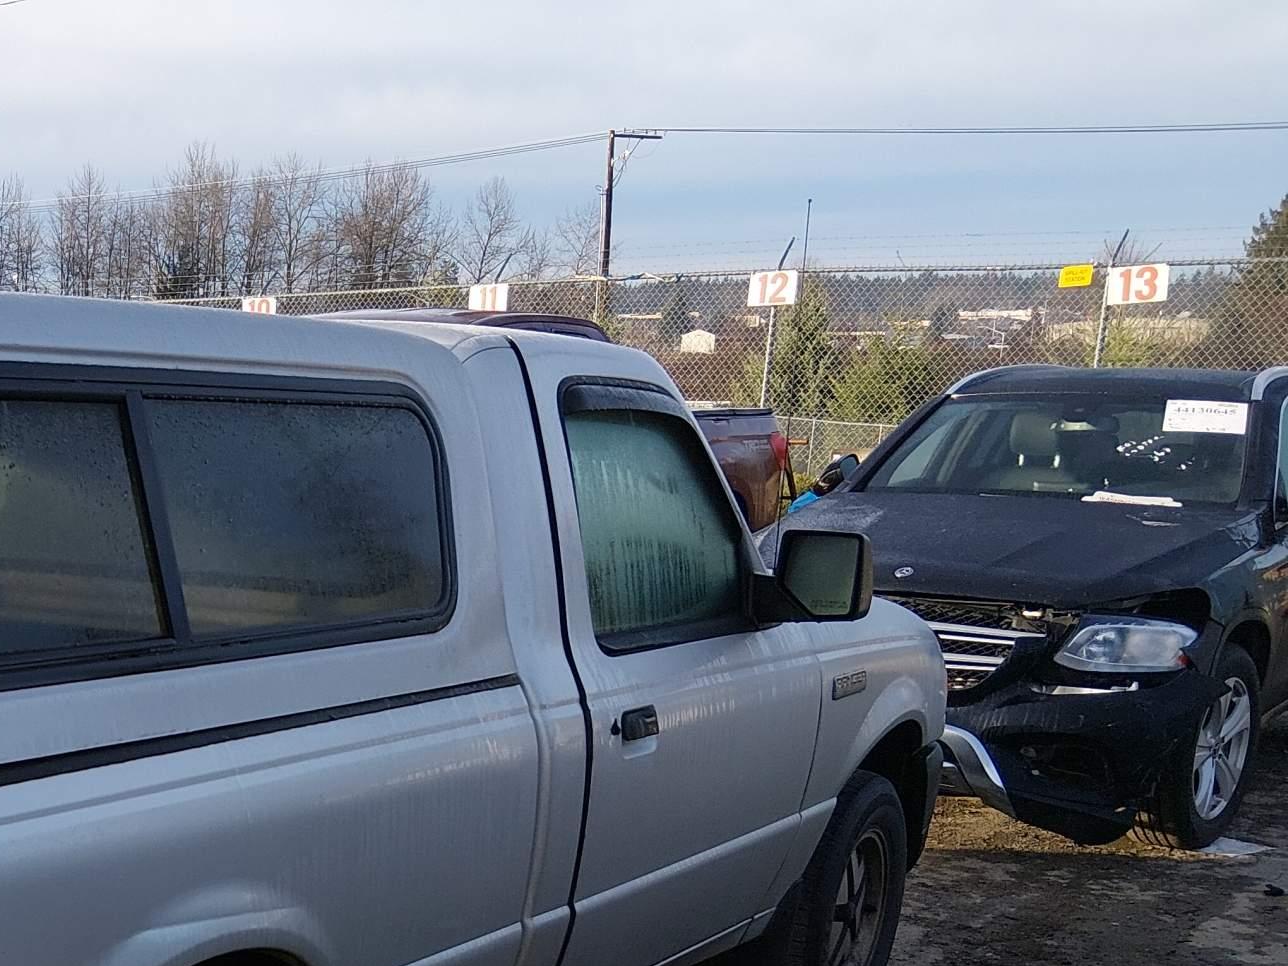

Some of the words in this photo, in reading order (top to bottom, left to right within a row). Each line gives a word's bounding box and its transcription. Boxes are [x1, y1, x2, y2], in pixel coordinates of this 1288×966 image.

[758, 272, 789, 303] 12
[1119, 266, 1158, 302] 13
[248, 299, 271, 315] 10
[479, 286, 498, 311] 11
